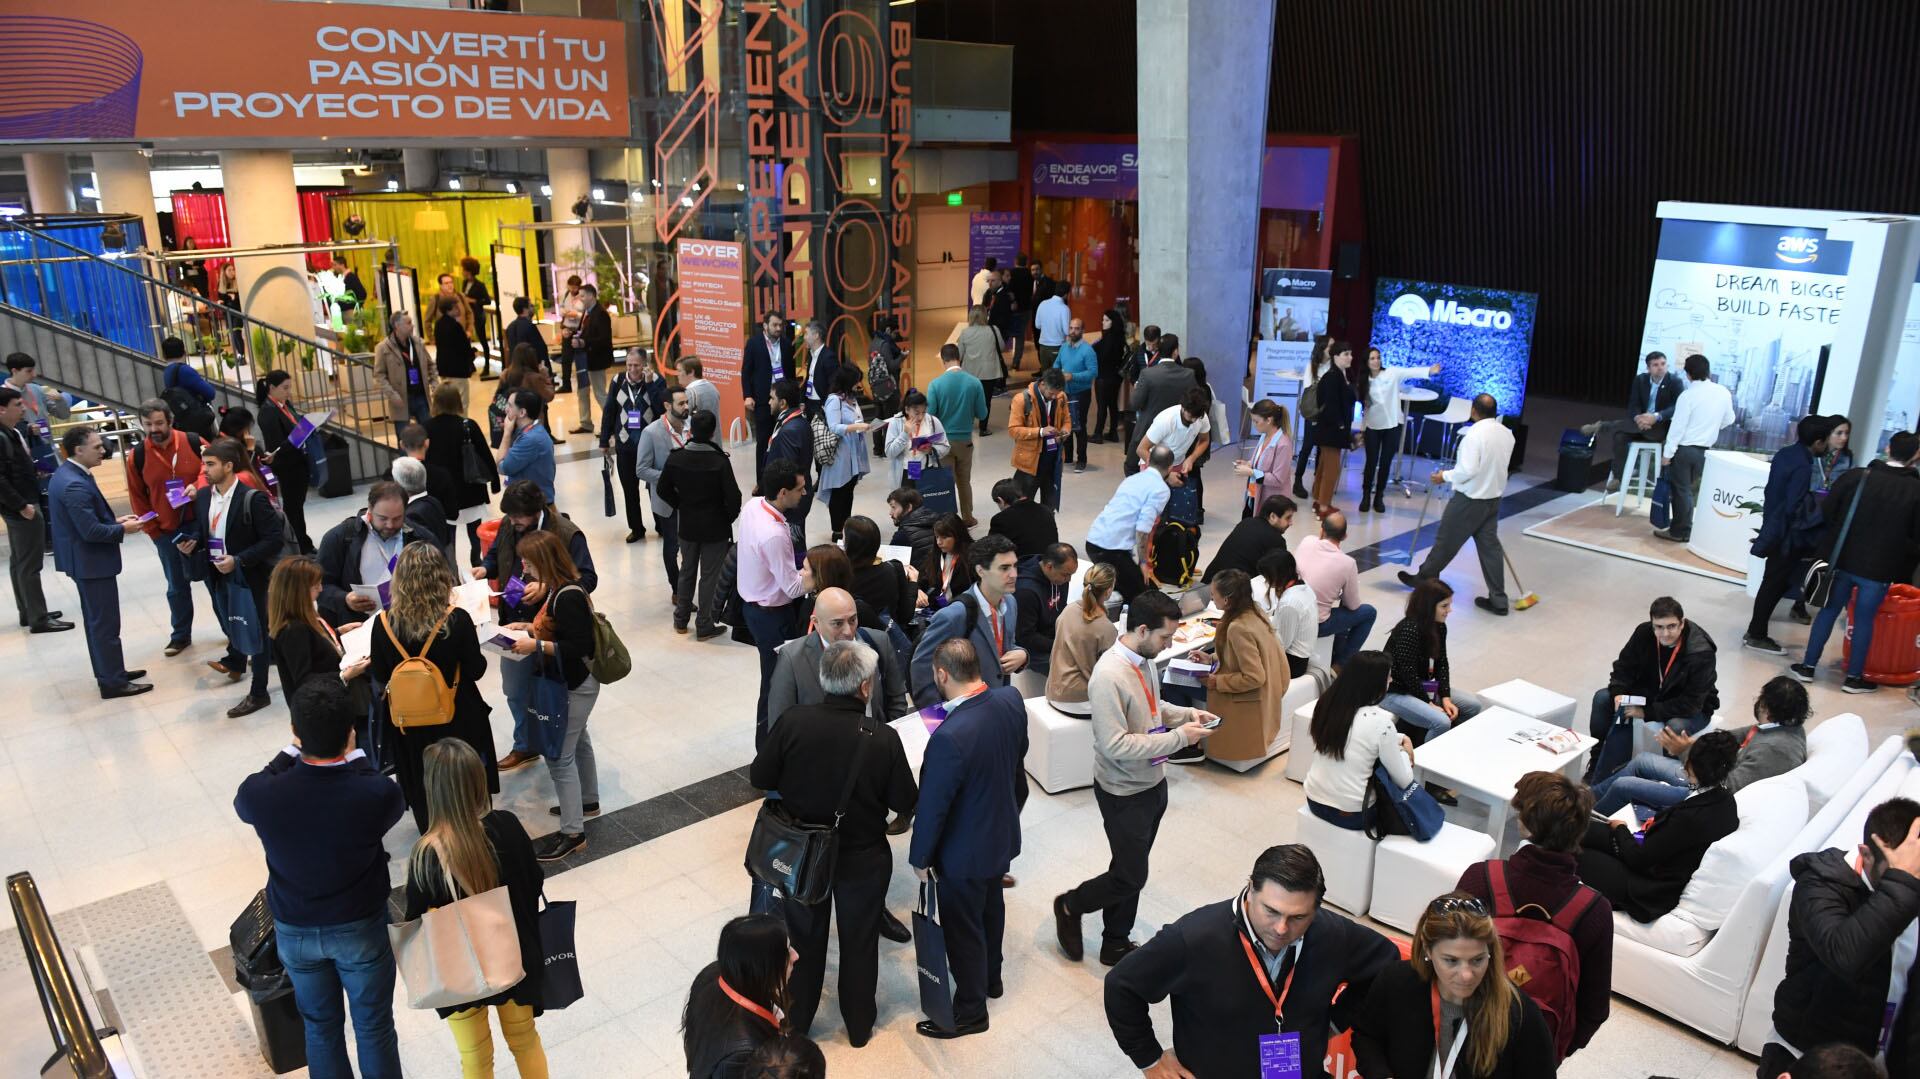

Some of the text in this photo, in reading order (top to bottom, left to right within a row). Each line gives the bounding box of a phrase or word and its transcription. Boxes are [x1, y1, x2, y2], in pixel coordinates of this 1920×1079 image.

[315, 25, 606, 62] CONVERTÍ TU
[308, 56, 609, 92] PASIÓN EN UN
[173, 92, 611, 120] PROYECTO DE VIDA
[890, 21, 912, 247] BUENOS
[776, 0, 814, 321] ENDEAV
[1049, 164, 1117, 175] ENDEAVOR
[1050, 174, 1090, 185] TALKS
[680, 243, 739, 258] FOYER
[1777, 236, 1819, 253] aws
[693, 281, 724, 289] FINTECH
[1291, 278, 1317, 288] Macro
[1715, 273, 1779, 295] DREAM
[694, 297, 723, 305] MODELO
[1717, 296, 1841, 325] BUILD FASTE
[1431, 299, 1512, 330] Macro
[1713, 485, 1744, 506] aws
